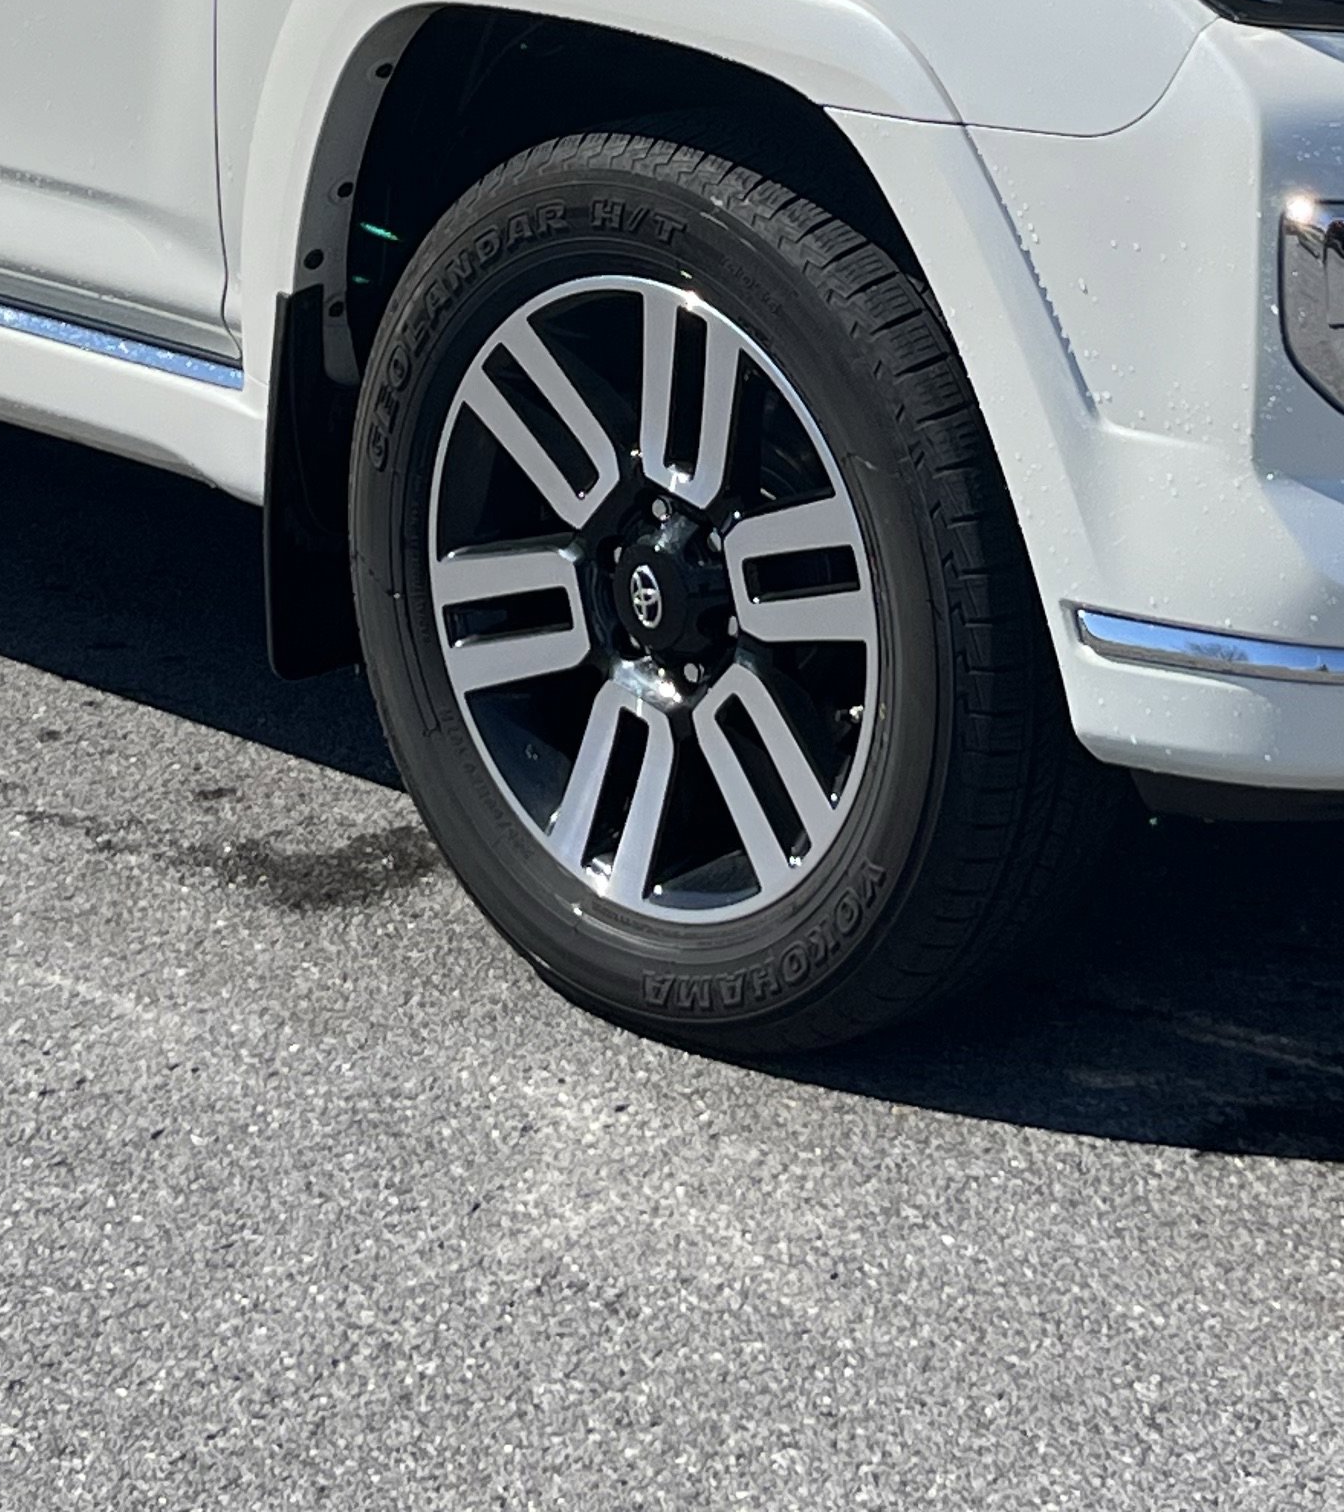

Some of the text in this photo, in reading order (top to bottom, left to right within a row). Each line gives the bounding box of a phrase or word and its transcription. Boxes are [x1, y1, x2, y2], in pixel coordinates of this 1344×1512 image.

[365, 196, 688, 473] GEOLANDAR H/T
[640, 856, 890, 1015] YOKOHAMA
